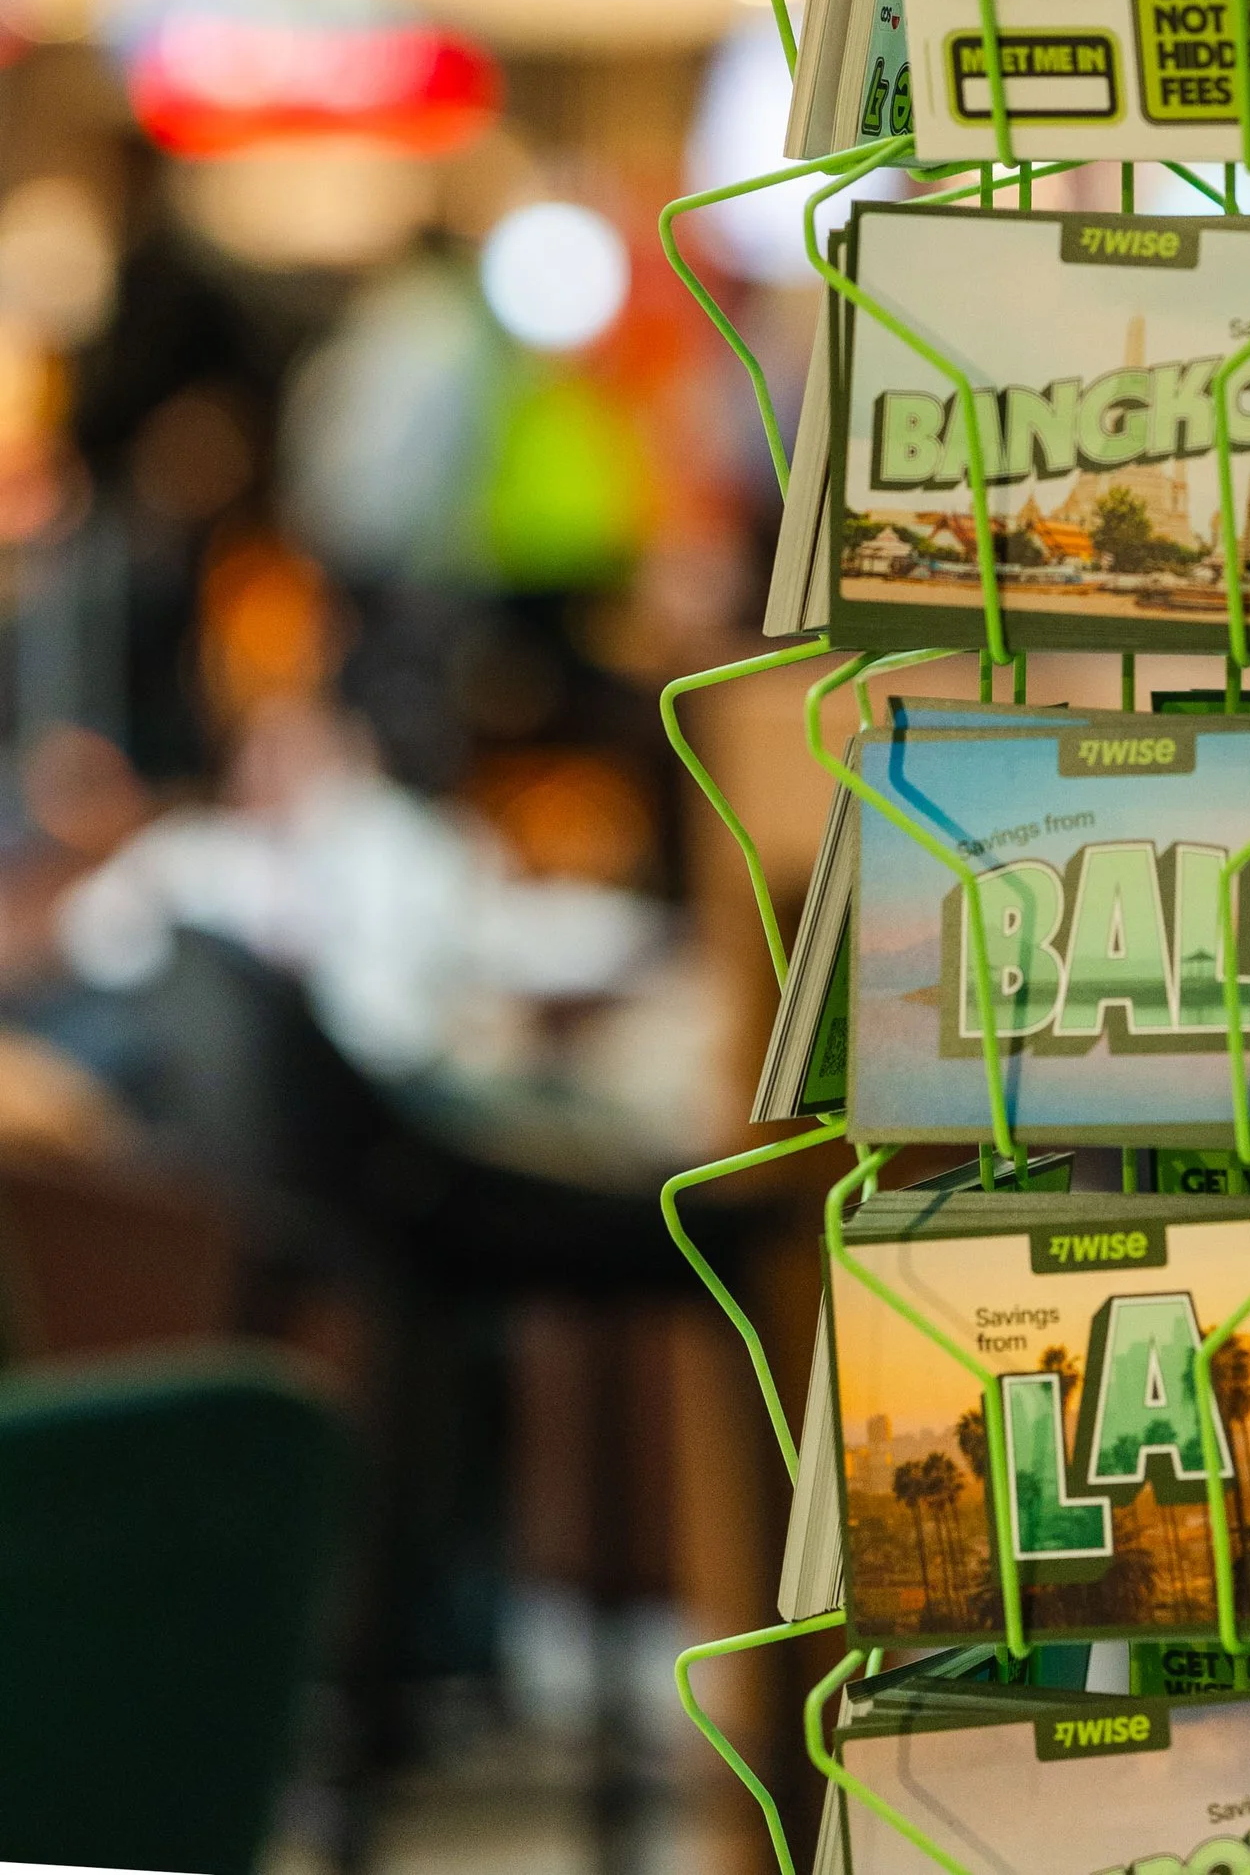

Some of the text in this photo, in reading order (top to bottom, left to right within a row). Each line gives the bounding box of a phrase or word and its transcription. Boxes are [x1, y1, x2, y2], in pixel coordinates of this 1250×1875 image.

[1154, 3, 1226, 35] NOT
[960, 45, 1030, 74] MET
[1160, 76, 1232, 106] FEES
[1045, 811, 1096, 834] from
[975, 1306, 1060, 1332] Savings
[976, 1332, 1028, 1354] from
[984, 1291, 1235, 1585] LA
[1163, 1649, 1219, 1679] GET
